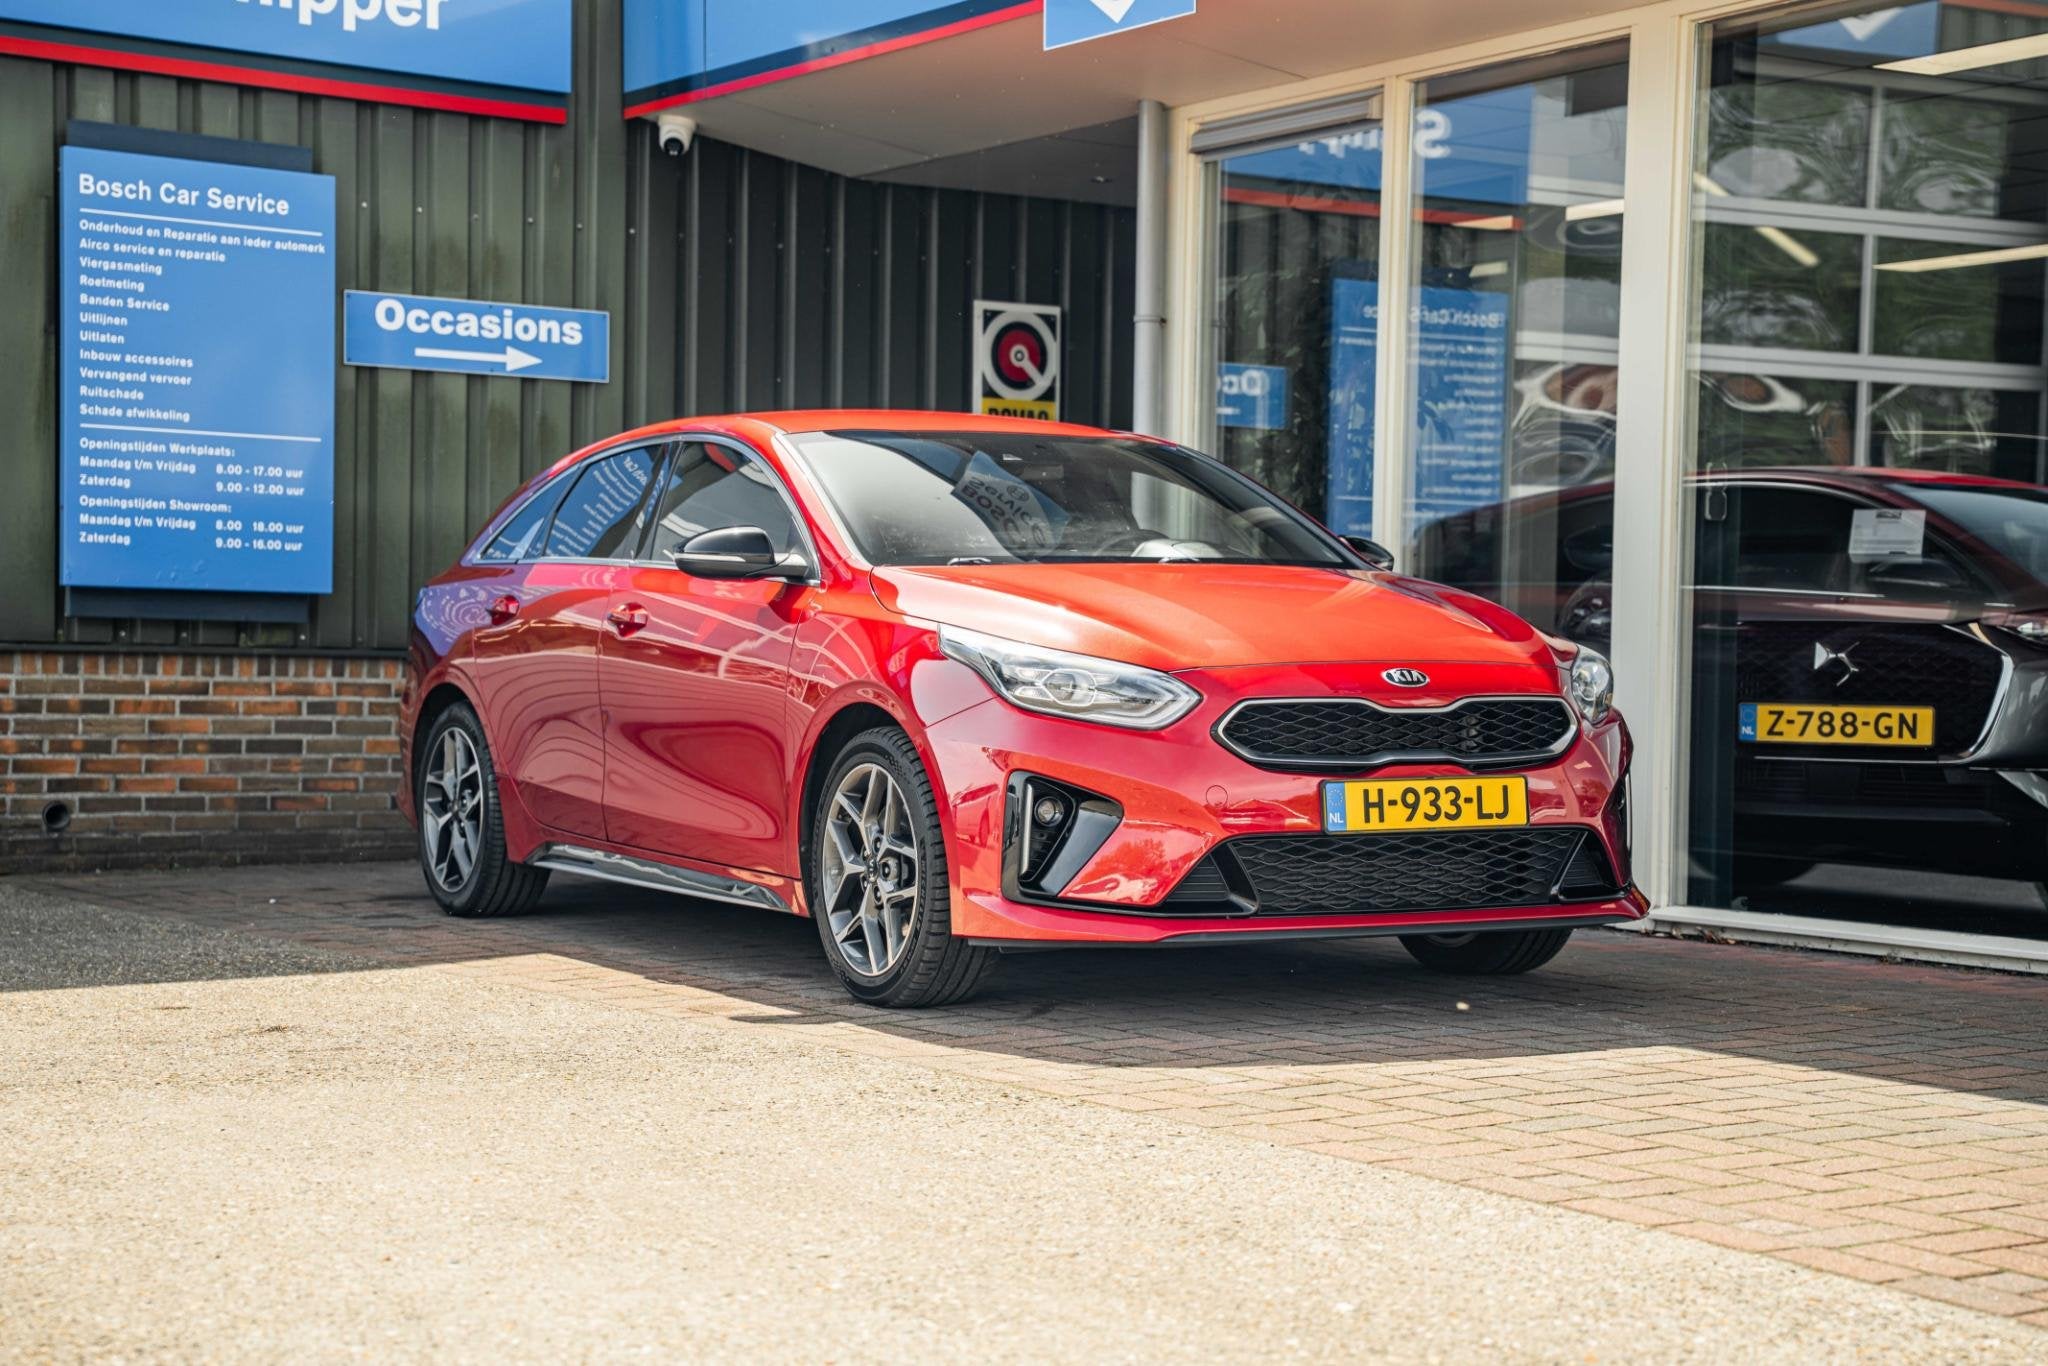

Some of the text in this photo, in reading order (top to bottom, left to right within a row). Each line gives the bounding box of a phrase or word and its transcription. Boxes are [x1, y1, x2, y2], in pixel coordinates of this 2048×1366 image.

[79, 173, 289, 215] Bosch Car Service
[79, 219, 326, 254] Onderhoud en Reparatie aan ieder automerk
[79, 238, 226, 263] Airco service en reparatie
[79, 257, 163, 276] Viergasmeting
[79, 275, 145, 293] Roetmeting
[79, 293, 170, 312] Banden Service
[79, 312, 128, 327] Uitlijnen
[375, 298, 583, 345] Occasions
[79, 330, 125, 345] Uitlaten
[79, 349, 194, 369] Inbouw accessoires
[79, 367, 192, 386] Vervangend vervoer
[79, 385, 144, 401] Ruitschade
[79, 403, 190, 423] Schade afwikkeling
[79, 437, 235, 457] Openingstijden Werkplaats:
[79, 456, 131, 471] Maandag
[134, 458, 153, 471] t/m
[156, 460, 196, 474] Vrijdag
[216, 464, 242, 476] 8.00
[253, 466, 283, 478] 17.00
[286, 469, 304, 479] uur
[79, 474, 131, 489] Zaterdag
[216, 482, 242, 494] 9.00
[253, 483, 284, 495] 12.00
[286, 486, 304, 496] uur
[79, 495, 232, 513] Openingstijden Showroom:
[79, 513, 131, 528] Maandag
[134, 515, 153, 528] t/m
[156, 517, 196, 531] Vrijdag
[215, 520, 242, 532] 8.00
[286, 524, 304, 534] uur
[79, 531, 131, 546] Zaterdag
[215, 538, 242, 550] 9.00
[284, 541, 303, 552] uur
[1391, 669, 1424, 683] KIA
[1741, 726, 1754, 736] NL
[1766, 710, 1918, 739] Z-788-GN
[1363, 785, 1510, 824] H-933-LJ
[1329, 812, 1344, 824] NL
